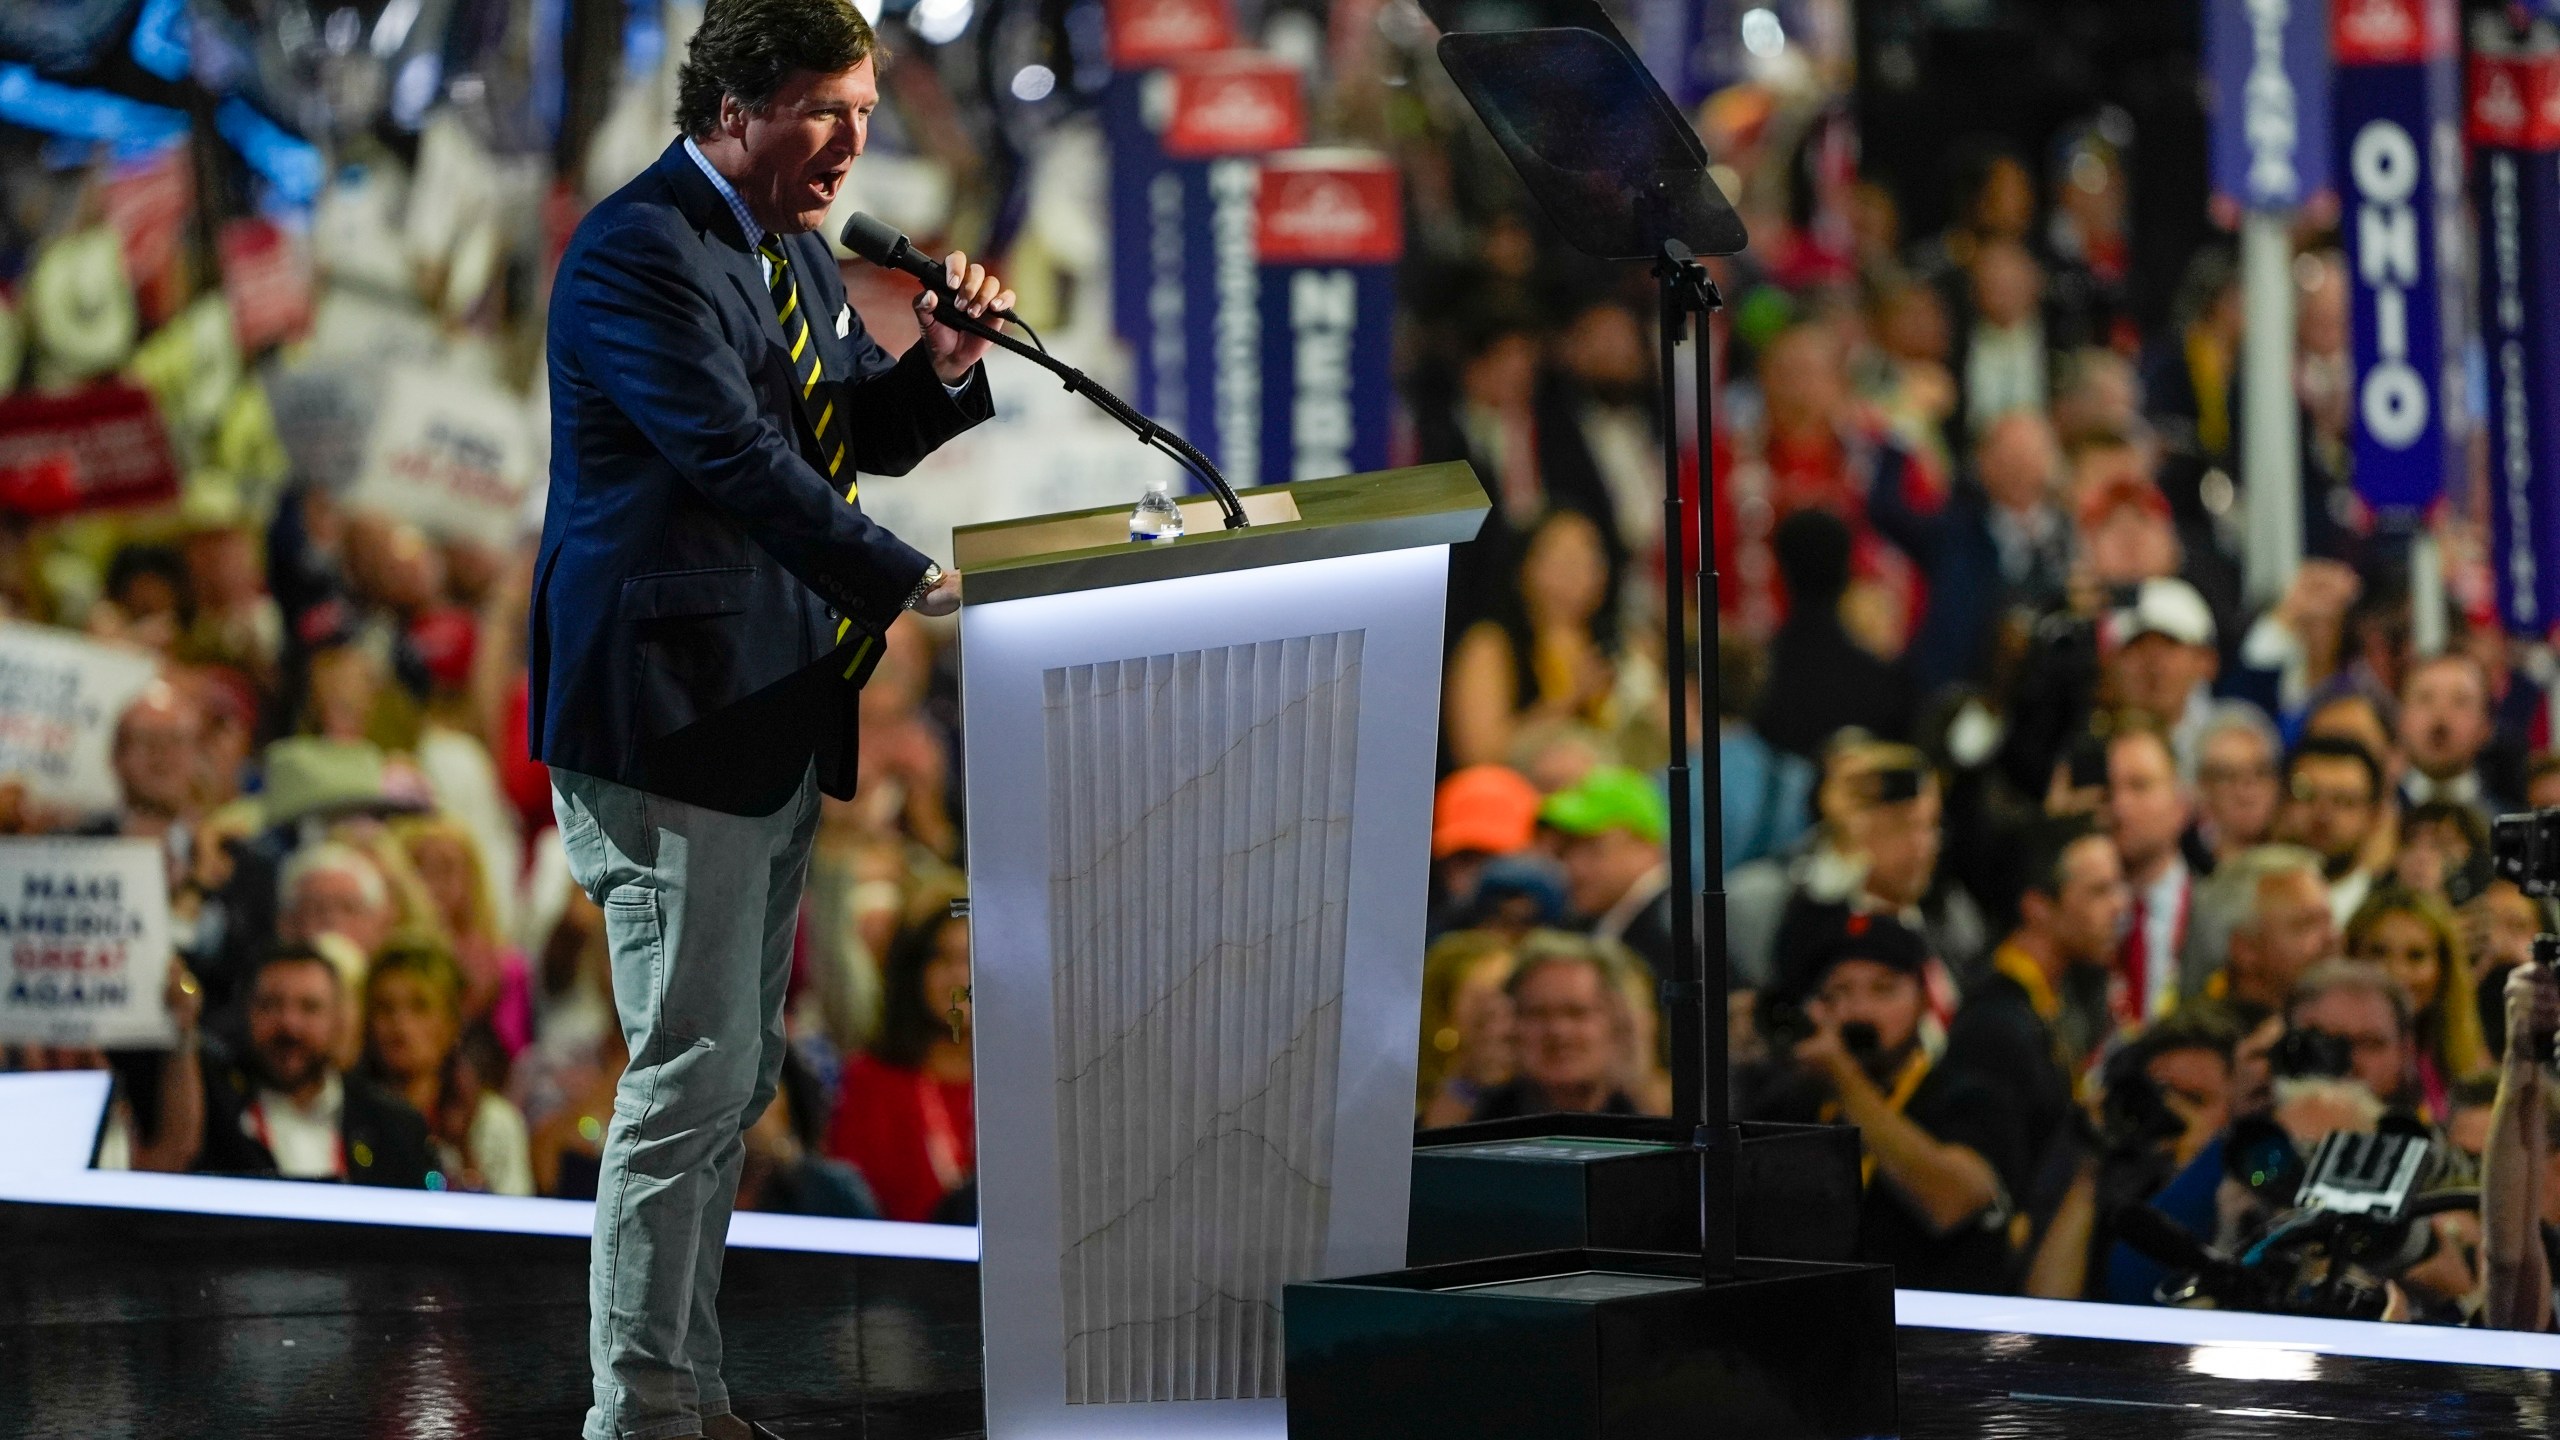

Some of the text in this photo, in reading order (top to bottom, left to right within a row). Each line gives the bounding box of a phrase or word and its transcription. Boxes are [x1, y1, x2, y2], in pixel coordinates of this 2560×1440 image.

[2350, 118, 2430, 452] OHIO
[23, 873, 121, 902] MAKE
[12, 941, 125, 974] GREAT
